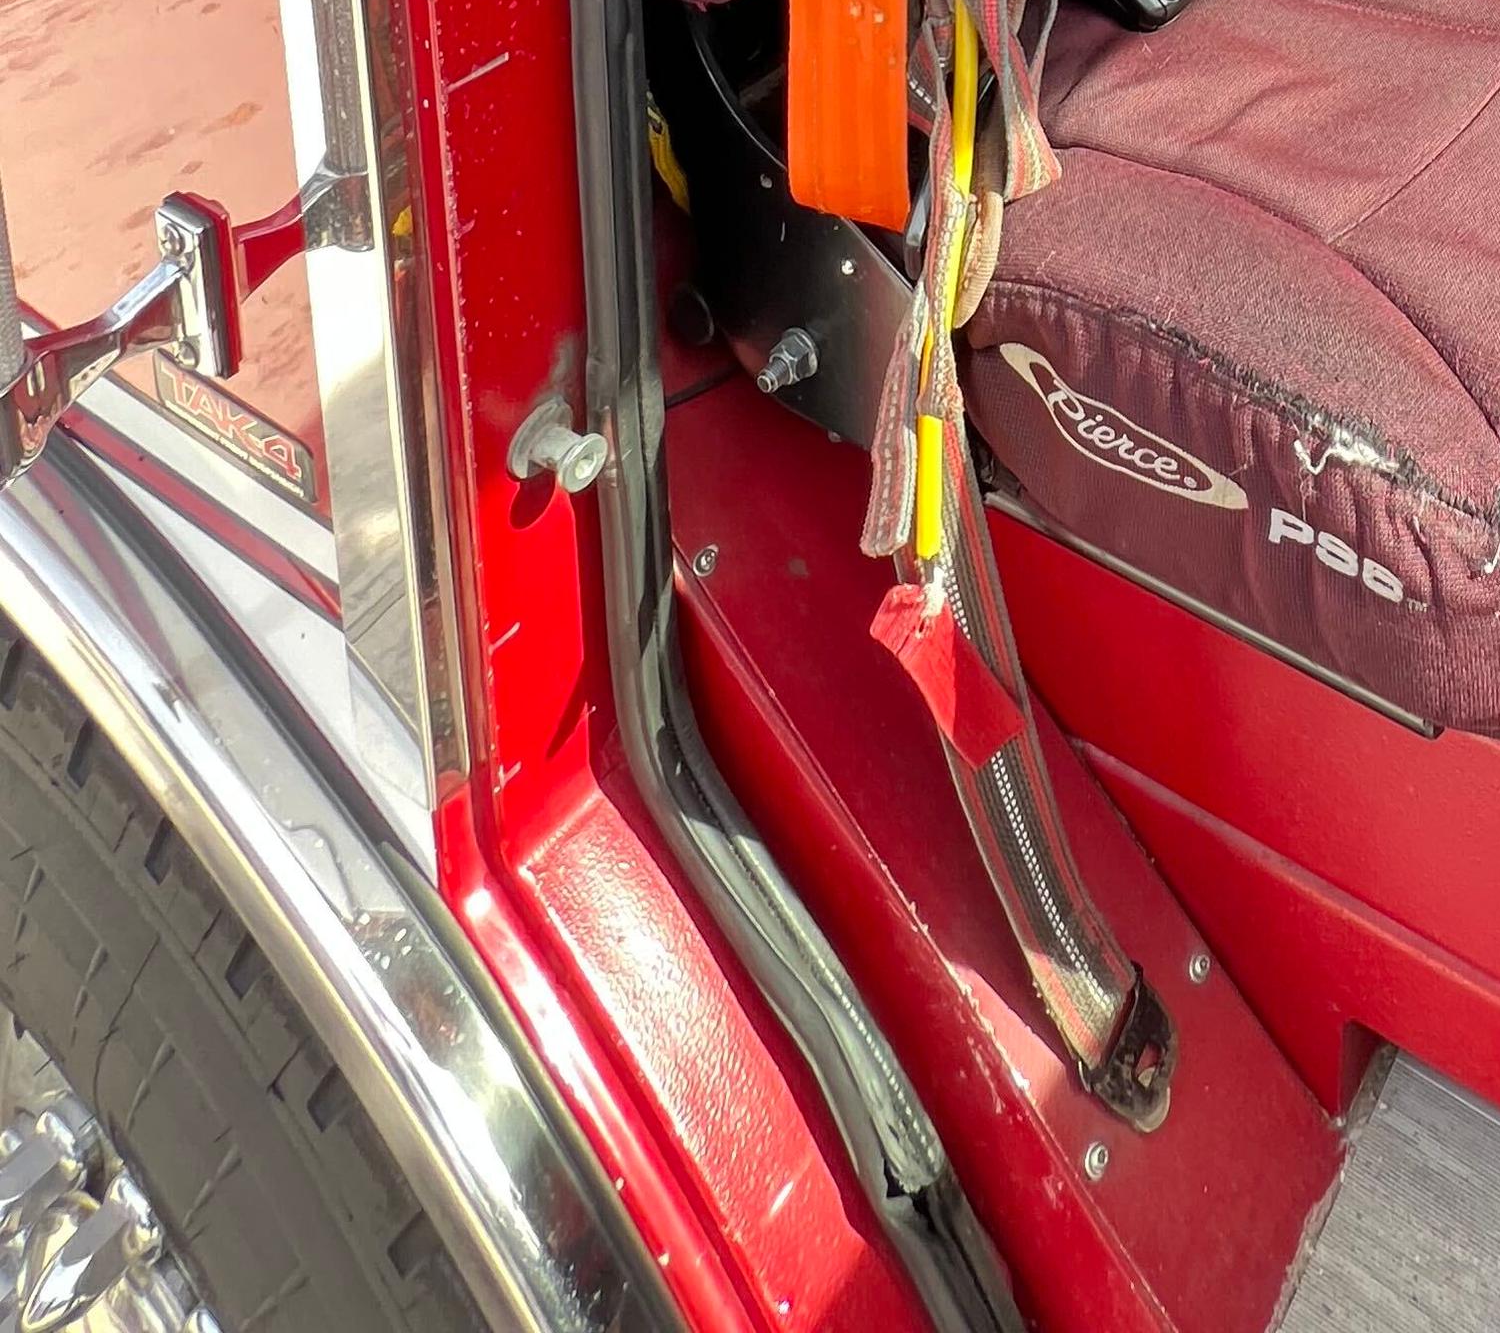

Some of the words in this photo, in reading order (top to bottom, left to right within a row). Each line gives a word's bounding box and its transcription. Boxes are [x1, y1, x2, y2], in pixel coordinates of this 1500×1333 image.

[160, 361, 302, 481] TAK-4
[1048, 380, 1180, 480] Pierce
[1268, 508, 1404, 603] PS6
